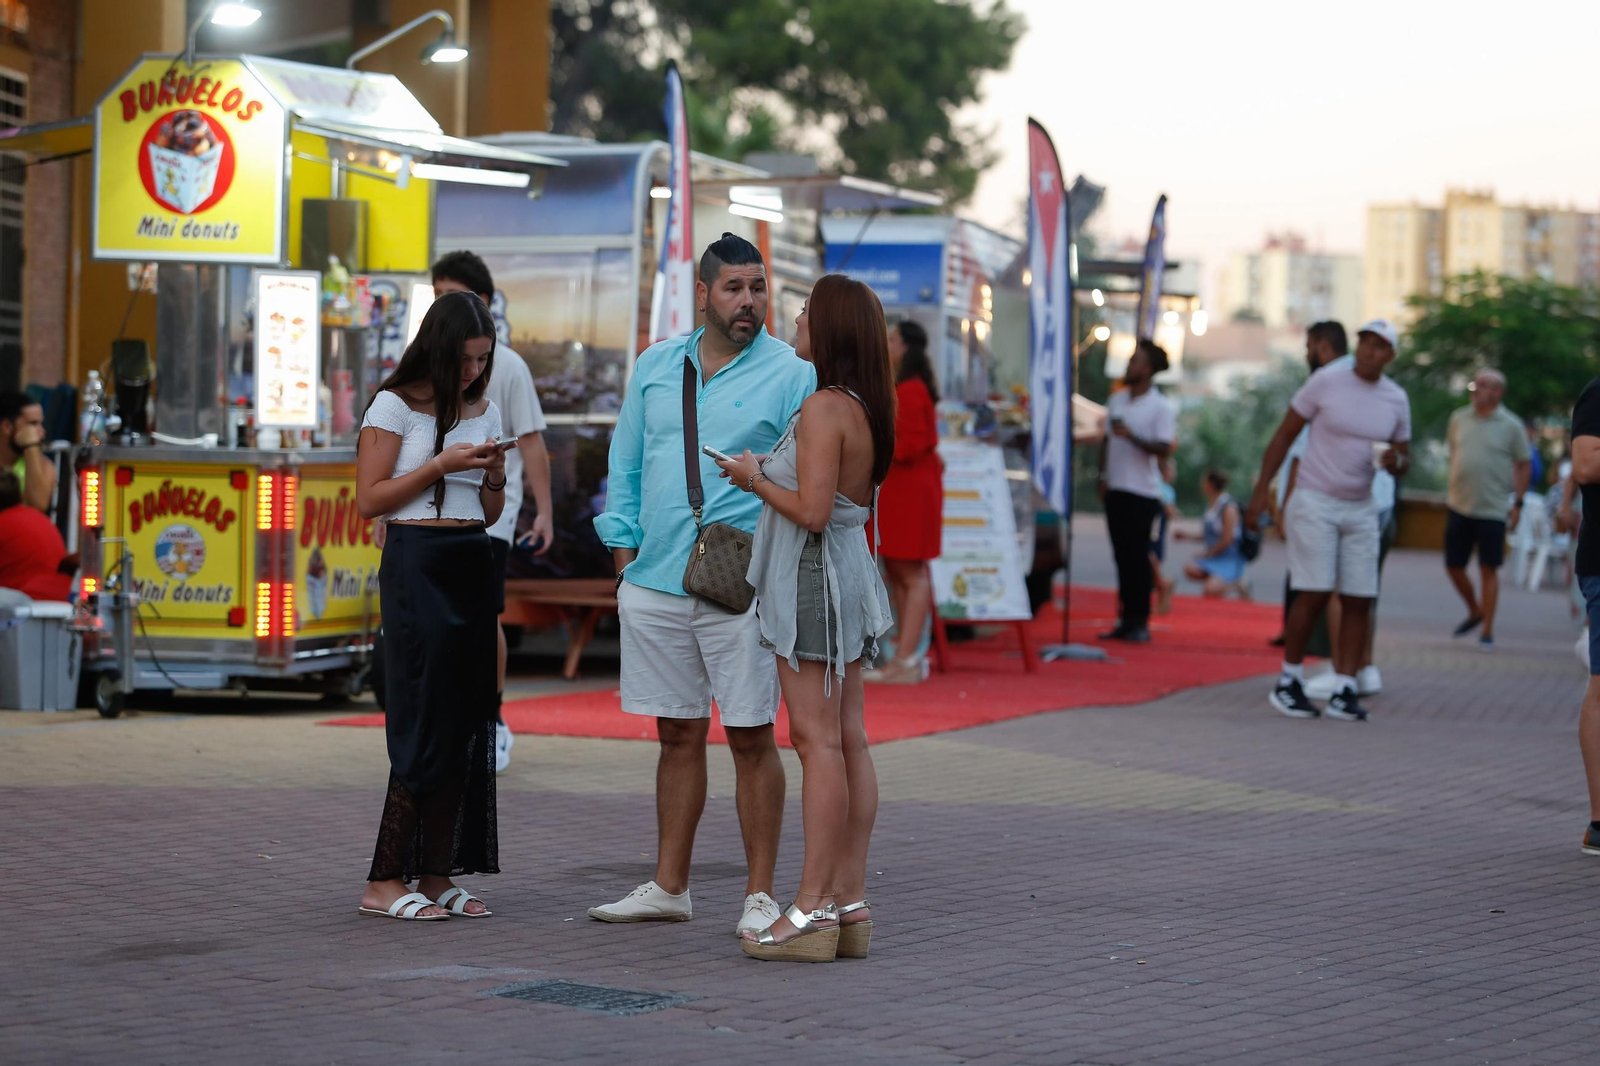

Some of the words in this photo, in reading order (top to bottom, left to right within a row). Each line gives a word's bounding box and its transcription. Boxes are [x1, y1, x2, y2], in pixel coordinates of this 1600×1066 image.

[119, 69, 264, 122] BUÑUELOS
[137, 214, 178, 238] Mini
[181, 216, 240, 241] donuts
[129, 480, 236, 533] BUÑUELOS
[133, 579, 169, 602] Mini
[172, 581, 234, 604] donuts
[331, 566, 363, 599] Mini
